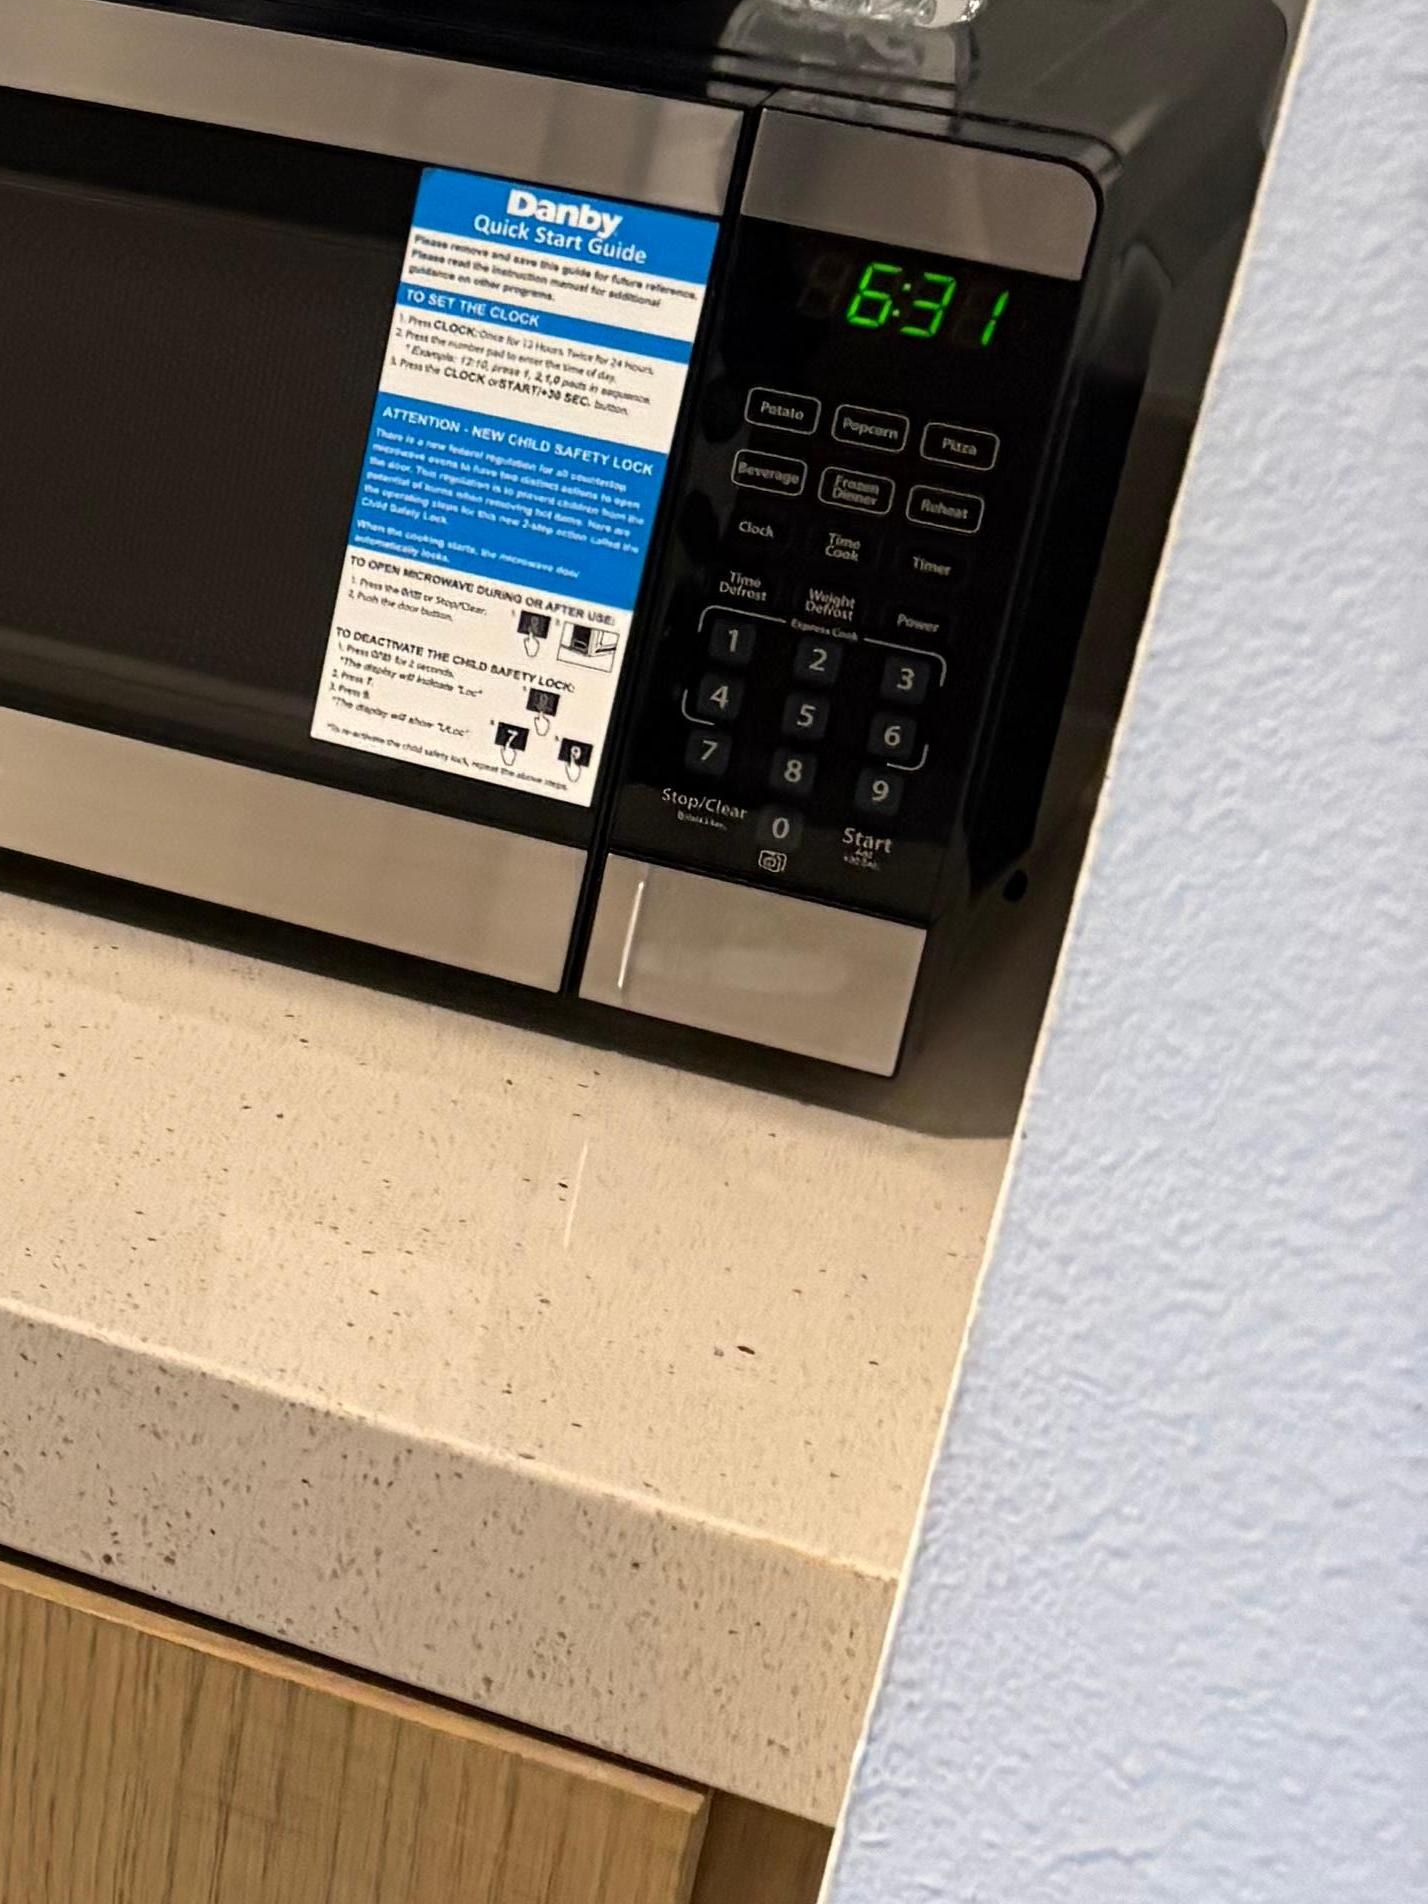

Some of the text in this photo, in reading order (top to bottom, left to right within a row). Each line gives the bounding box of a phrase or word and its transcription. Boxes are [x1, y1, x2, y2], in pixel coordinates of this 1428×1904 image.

[506, 189, 623, 239] Danby
[474, 214, 647, 264] Quick Start Guide
[414, 234, 448, 249] Please
[450, 243, 488, 257] remove
[491, 250, 510, 262] and
[513, 256, 537, 267] save
[562, 265, 591, 278] guide
[594, 270, 609, 282] for
[611, 274, 643, 288] future
[411, 249, 661, 308] Please read the instruction manual for additional
[473, 278, 500, 290] other
[406, 288, 540, 328] TO SET THE CLOCK
[846, 262, 1010, 346] 6:31
[443, 367, 485, 384] CLOCK
[760, 400, 899, 440] Potato Popcorn
[382, 405, 654, 477] ATTENTION NEW CHILD SAFETY LOCK
[737, 461, 800, 486] Beverage
[834, 474, 880, 495] Frozen
[920, 498, 969, 520] Reheat
[738, 520, 775, 539] Clock
[828, 532, 862, 550] Time
[825, 546, 859, 563] Cook
[912, 554, 953, 576] Timer
[350, 555, 366, 568] TO
[368, 559, 401, 576] OPEN
[403, 567, 475, 593] MICROWAVE
[476, 584, 523, 605] DURING
[525, 596, 543, 609] OR
[545, 600, 585, 619] AFTER
[719, 580, 767, 602] Defrost
[729, 569, 762, 589] Time
[804, 599, 854, 622] Defrost
[808, 587, 856, 610] Weight
[897, 612, 940, 633] Power
[727, 628, 739, 653] 1
[336, 626, 351, 639] TO
[353, 631, 425, 657] DEACTIVATE
[427, 648, 451, 663] THE
[452, 655, 488, 672] CHILD
[490, 665, 537, 683] SAFETY
[808, 648, 828, 672] 2
[896, 667, 915, 691] 3
[709, 684, 729, 710] 4
[796, 703, 817, 727] 5
[884, 725, 901, 746] 6
[700, 739, 719, 761] 7
[783, 758, 803, 783] 8
[661, 787, 748, 819] Stop/Clear
[871, 779, 890, 803] 9
[771, 817, 790, 839] 0
[842, 827, 893, 855] Start
